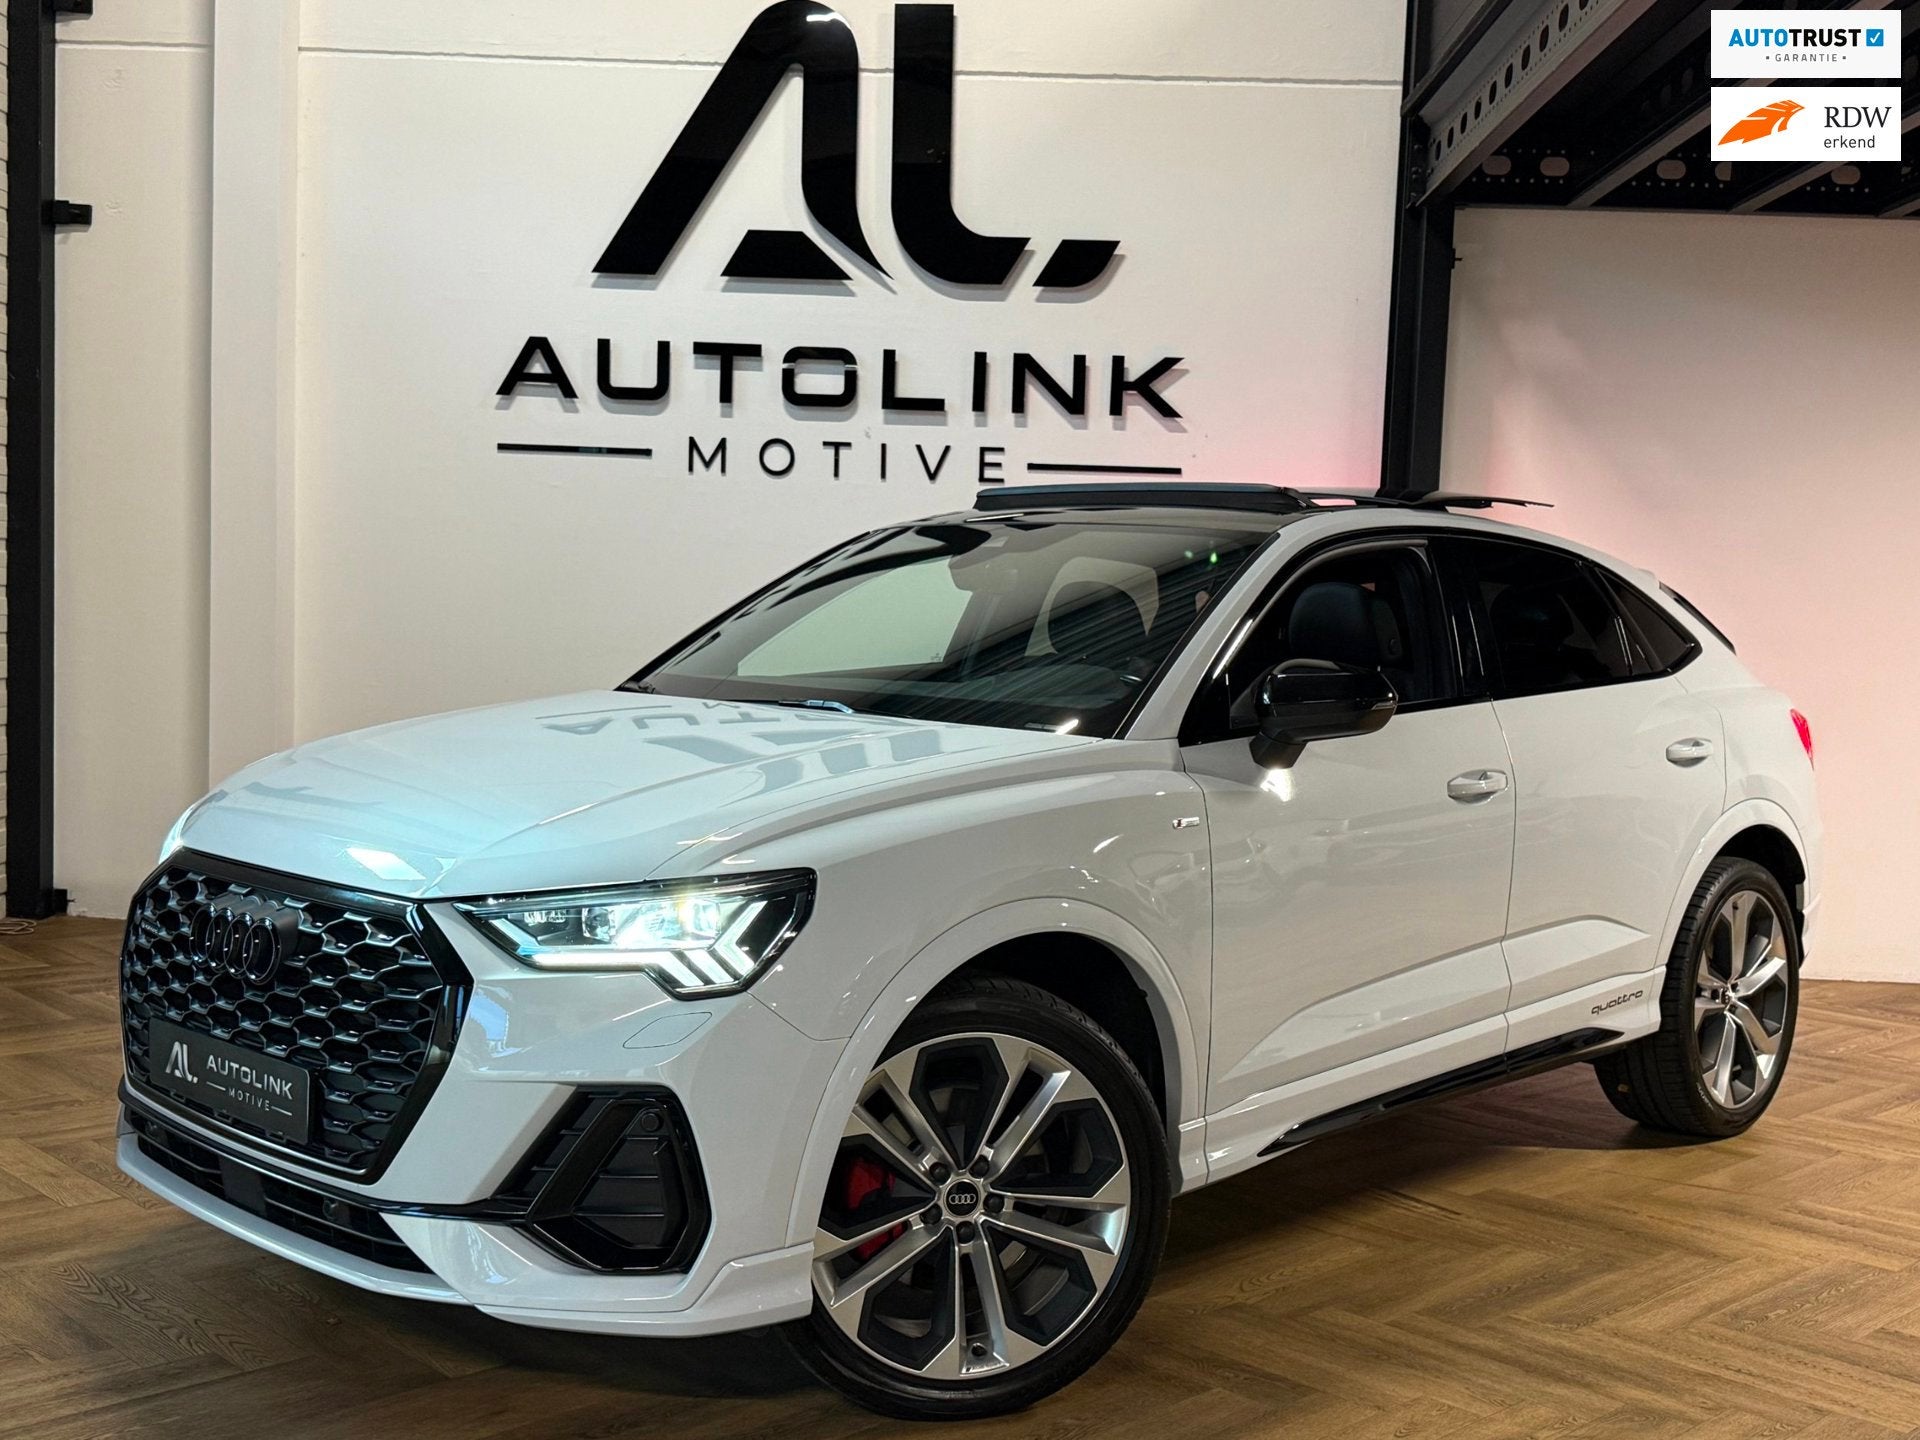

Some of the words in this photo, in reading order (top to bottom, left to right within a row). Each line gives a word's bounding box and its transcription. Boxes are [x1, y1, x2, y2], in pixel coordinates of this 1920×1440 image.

[495, 336, 1185, 419] AUTOLINK
[687, 435, 1006, 484] MOTIVE
[1591, 990, 1644, 1015] quattro
[206, 1054, 293, 1100] AUTOLINK
[228, 1087, 270, 1111] MOTIVE
